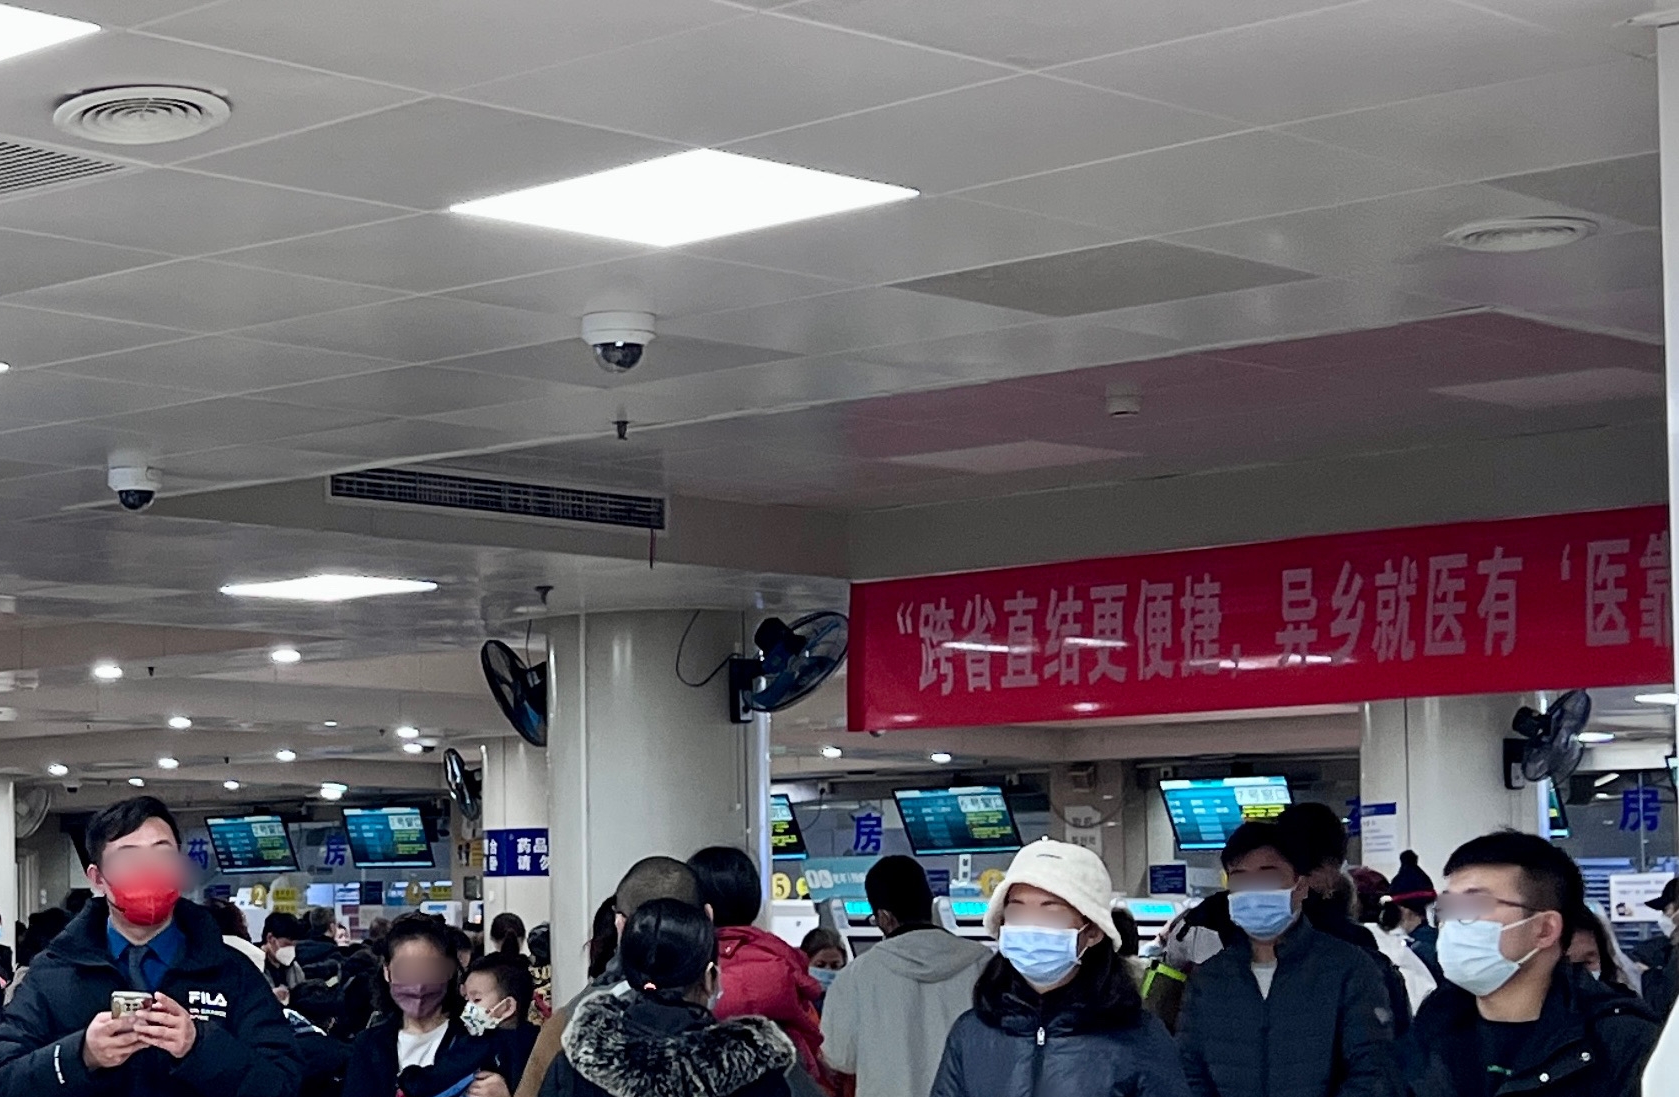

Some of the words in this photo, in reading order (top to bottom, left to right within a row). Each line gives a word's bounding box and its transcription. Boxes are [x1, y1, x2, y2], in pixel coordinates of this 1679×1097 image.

[1619, 787, 1661, 831] 房
[516, 837, 548, 854] 药品
[853, 813, 883, 851] 房
[324, 834, 346, 866] 房
[188, 990, 228, 1007] FILA
